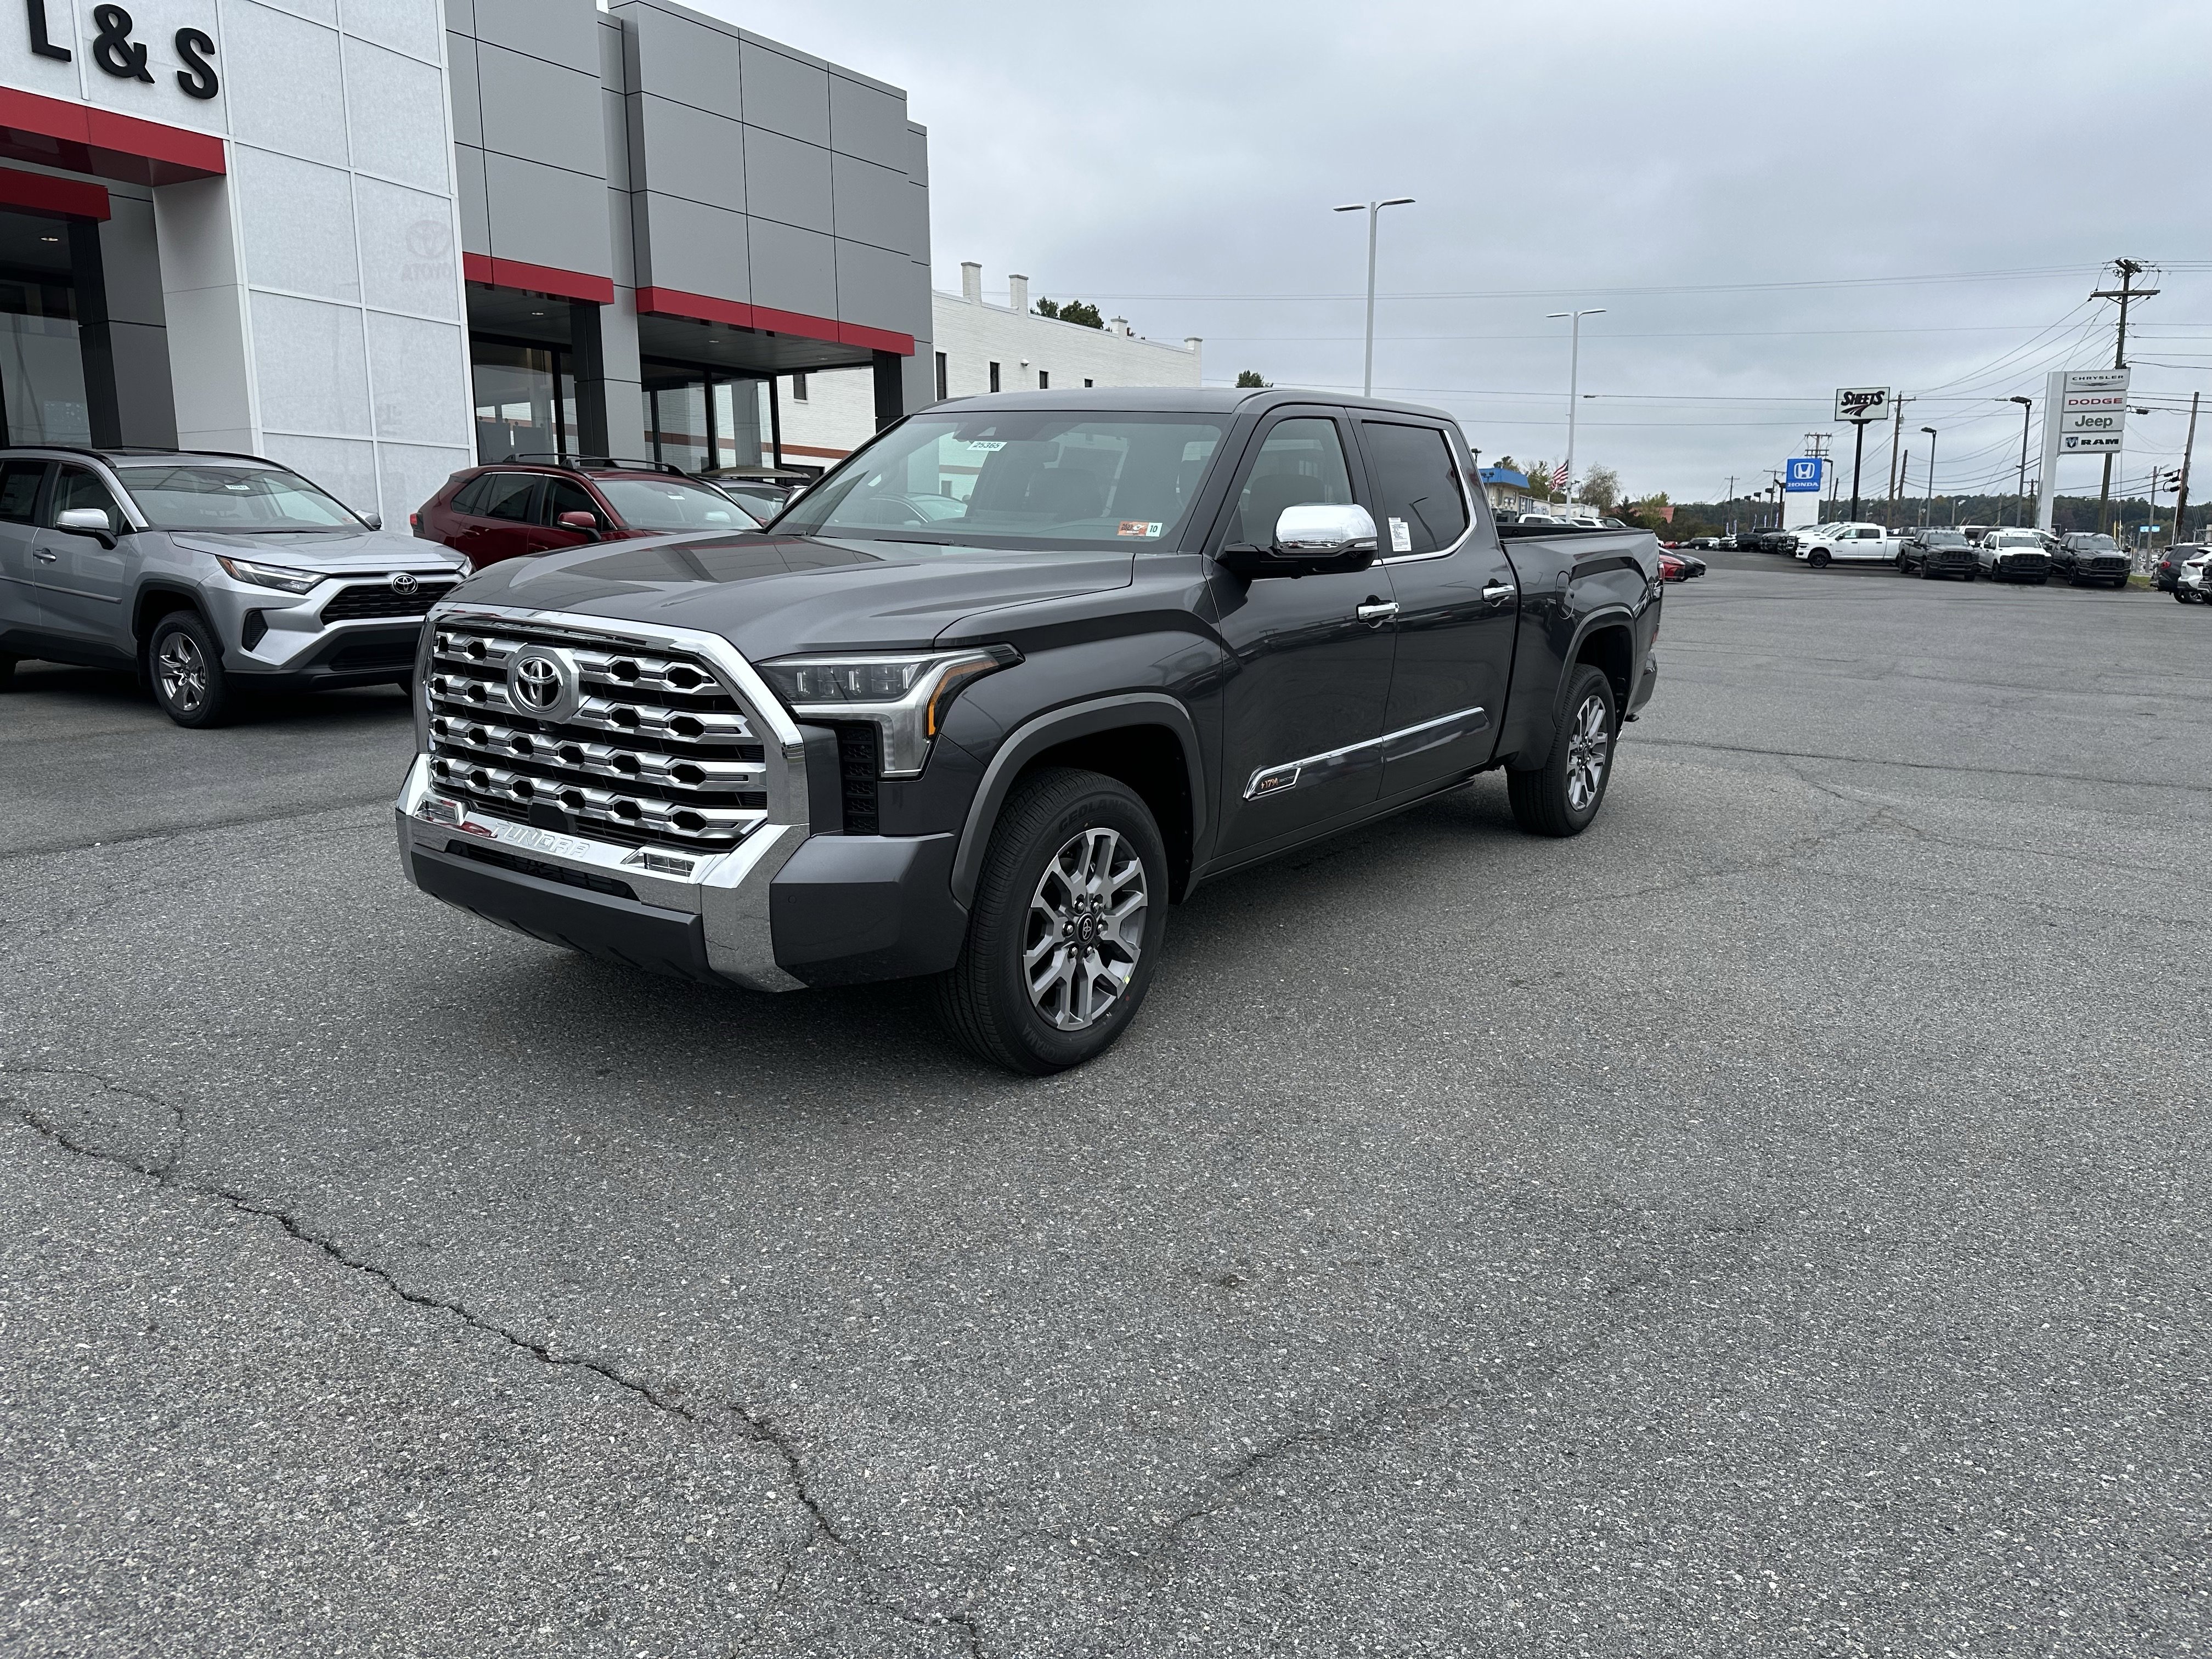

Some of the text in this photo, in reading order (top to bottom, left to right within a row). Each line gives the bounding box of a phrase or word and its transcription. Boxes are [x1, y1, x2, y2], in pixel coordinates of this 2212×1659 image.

[27, 0, 219, 100] L & S
[2075, 415, 2113, 428] Jeep
[490, 822, 590, 858] TUNDRA
